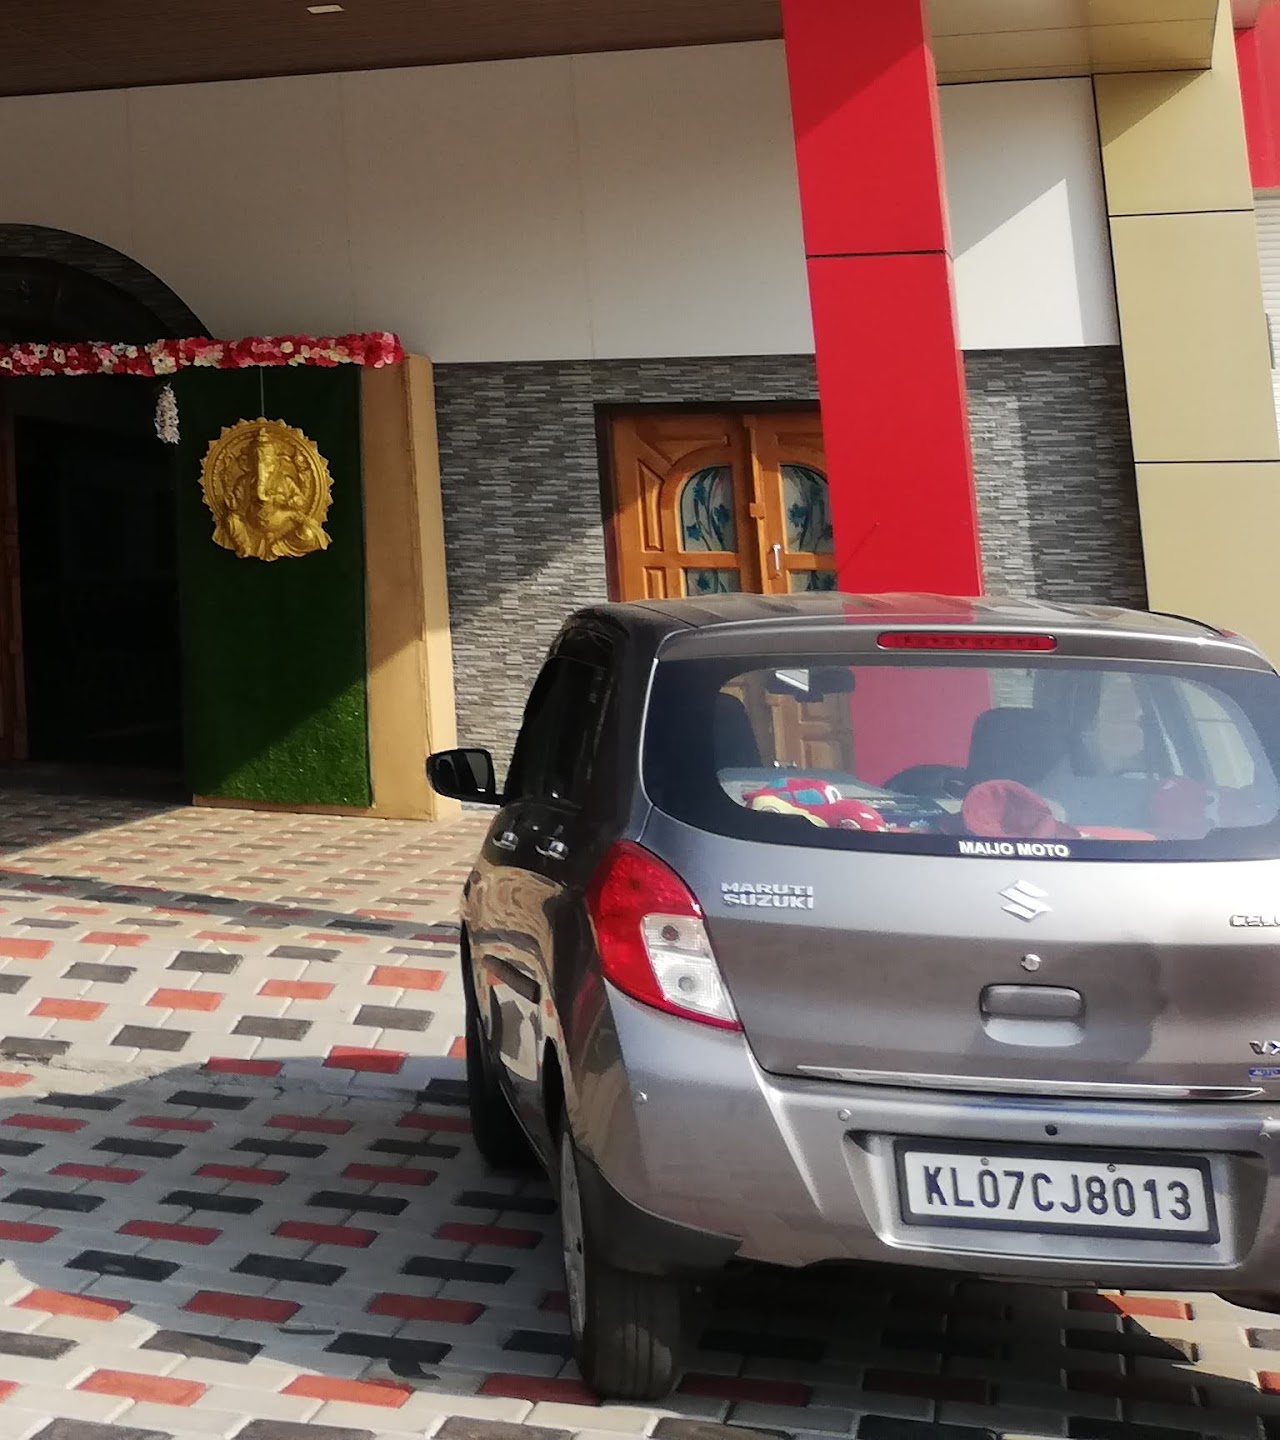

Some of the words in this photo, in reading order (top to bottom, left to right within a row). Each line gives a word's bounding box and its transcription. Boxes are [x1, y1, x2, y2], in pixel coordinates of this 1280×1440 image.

[959, 840, 1015, 856] MAIJO
[1016, 842, 1071, 858] MOTO
[720, 882, 814, 896] MARUTI
[722, 893, 814, 910] SUZUKI
[923, 1165, 1192, 1221] KL07CJ8013
